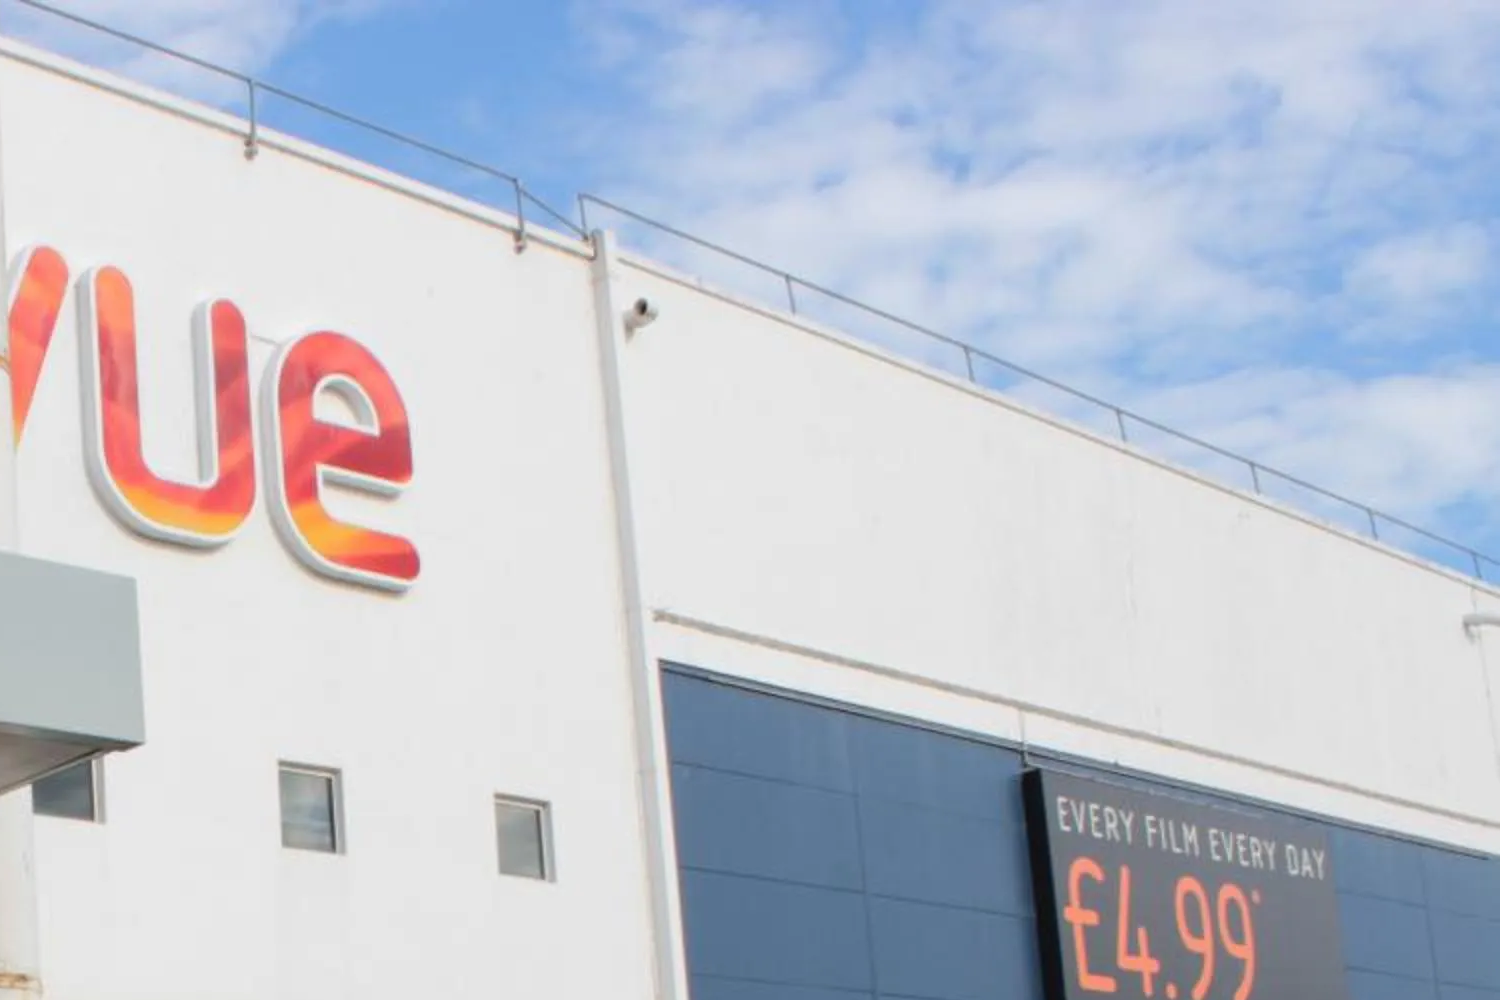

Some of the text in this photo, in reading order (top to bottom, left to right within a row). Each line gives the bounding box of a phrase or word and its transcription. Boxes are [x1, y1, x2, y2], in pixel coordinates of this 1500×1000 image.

[1056, 796, 1326, 880] EVERY FILM EVERY DAY
